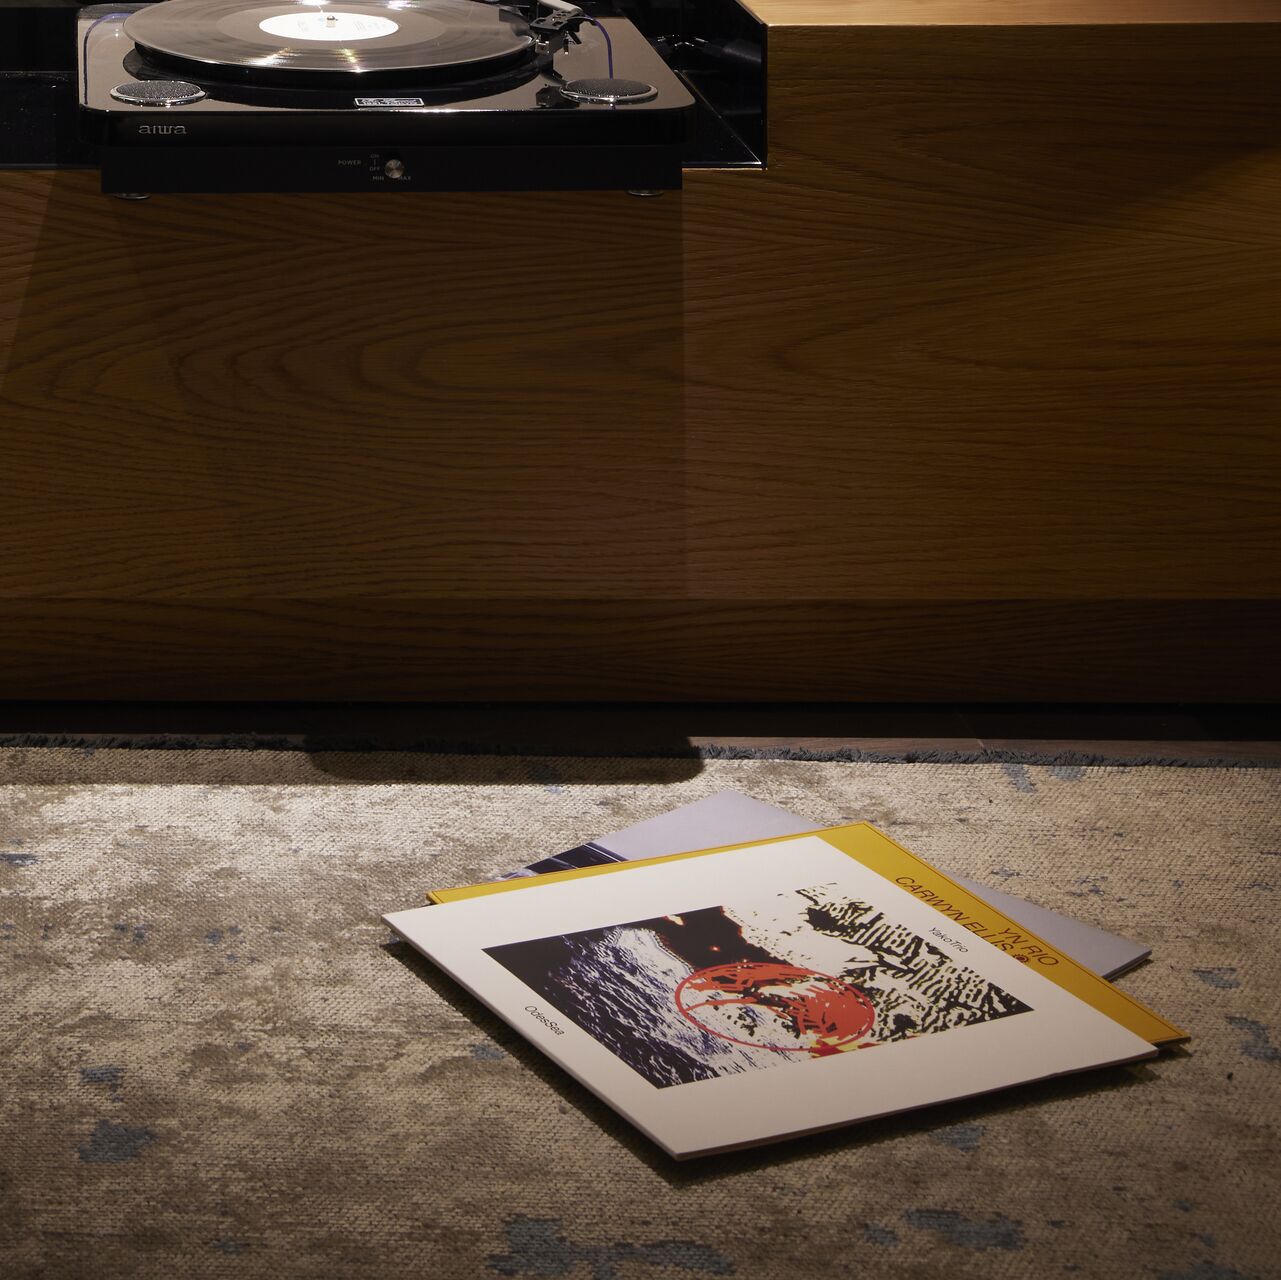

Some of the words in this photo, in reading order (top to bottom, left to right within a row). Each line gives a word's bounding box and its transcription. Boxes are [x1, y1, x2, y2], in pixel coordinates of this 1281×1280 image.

[138, 125, 187, 135] aiwa
[895, 876, 970, 921] CARWYN
[962, 921, 1015, 952] ELLIS
[998, 927, 1028, 946] YN
[1021, 944, 1059, 966] RIO
[524, 1005, 565, 1036] OdesSea
